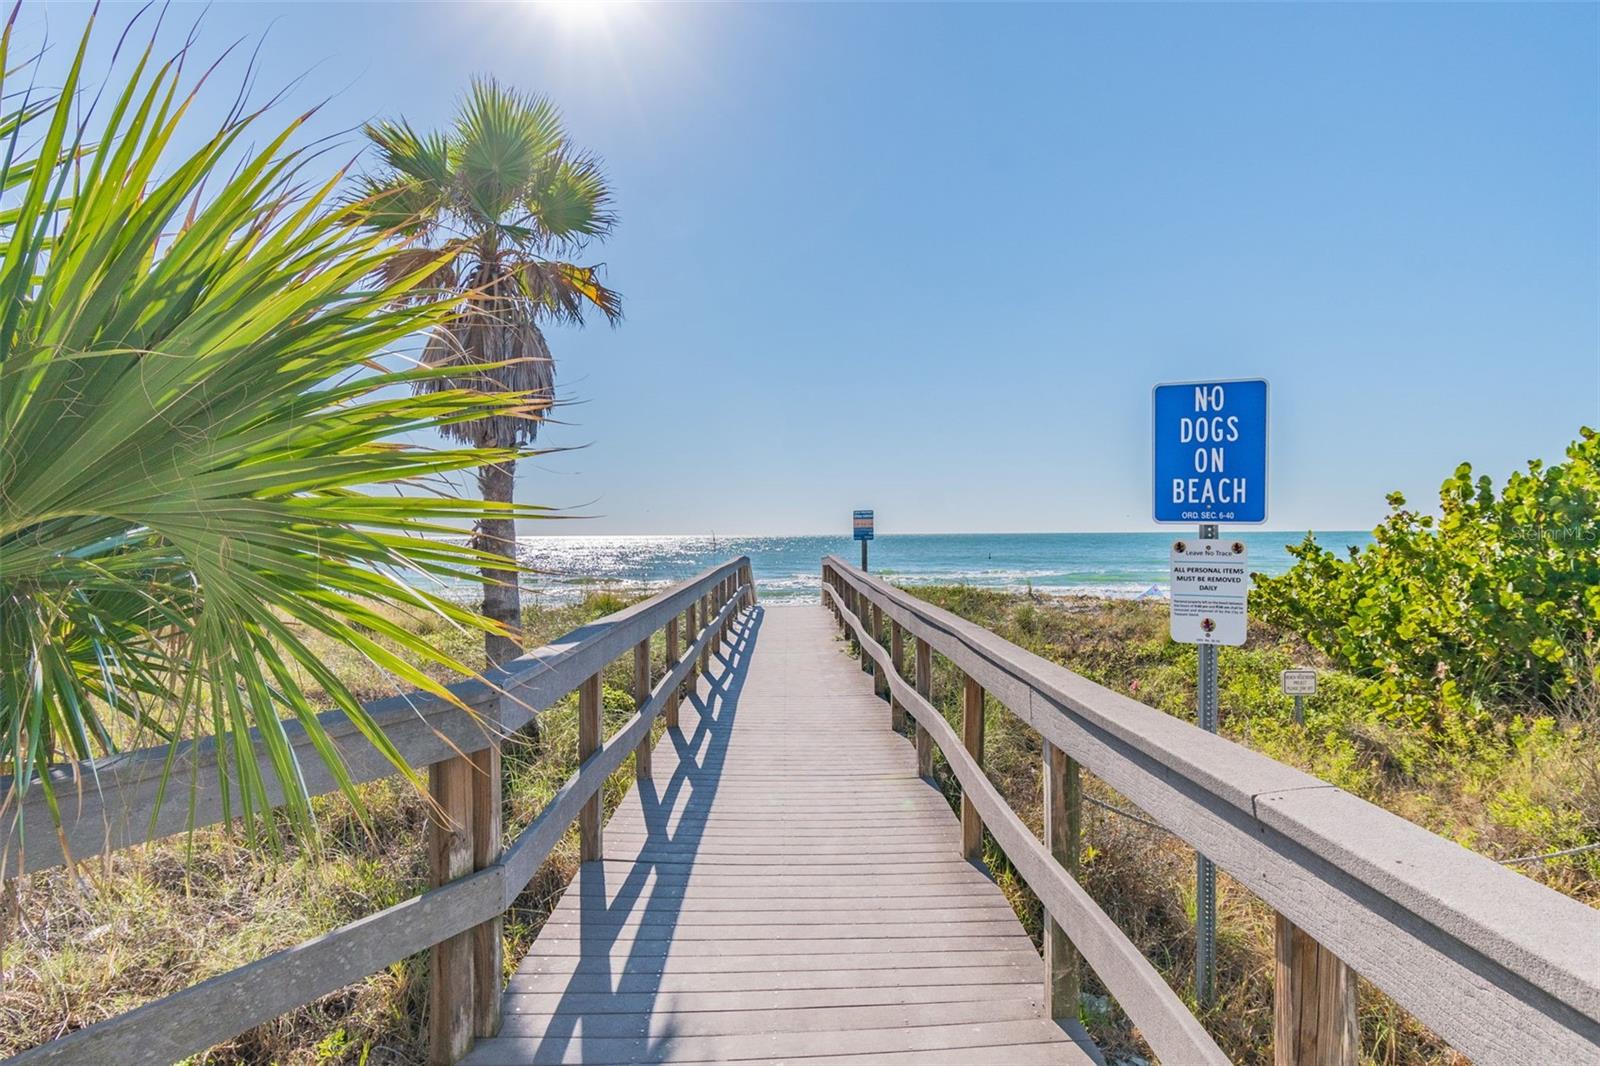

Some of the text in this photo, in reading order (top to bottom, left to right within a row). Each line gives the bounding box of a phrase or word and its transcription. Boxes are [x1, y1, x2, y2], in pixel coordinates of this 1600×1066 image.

[1195, 386, 1224, 412] NO
[1181, 416, 1239, 443] DOGS
[1195, 447, 1224, 473] ON
[1173, 478, 1246, 504] BEACH
[1182, 511, 1235, 520] ORD. SEC. 6-40
